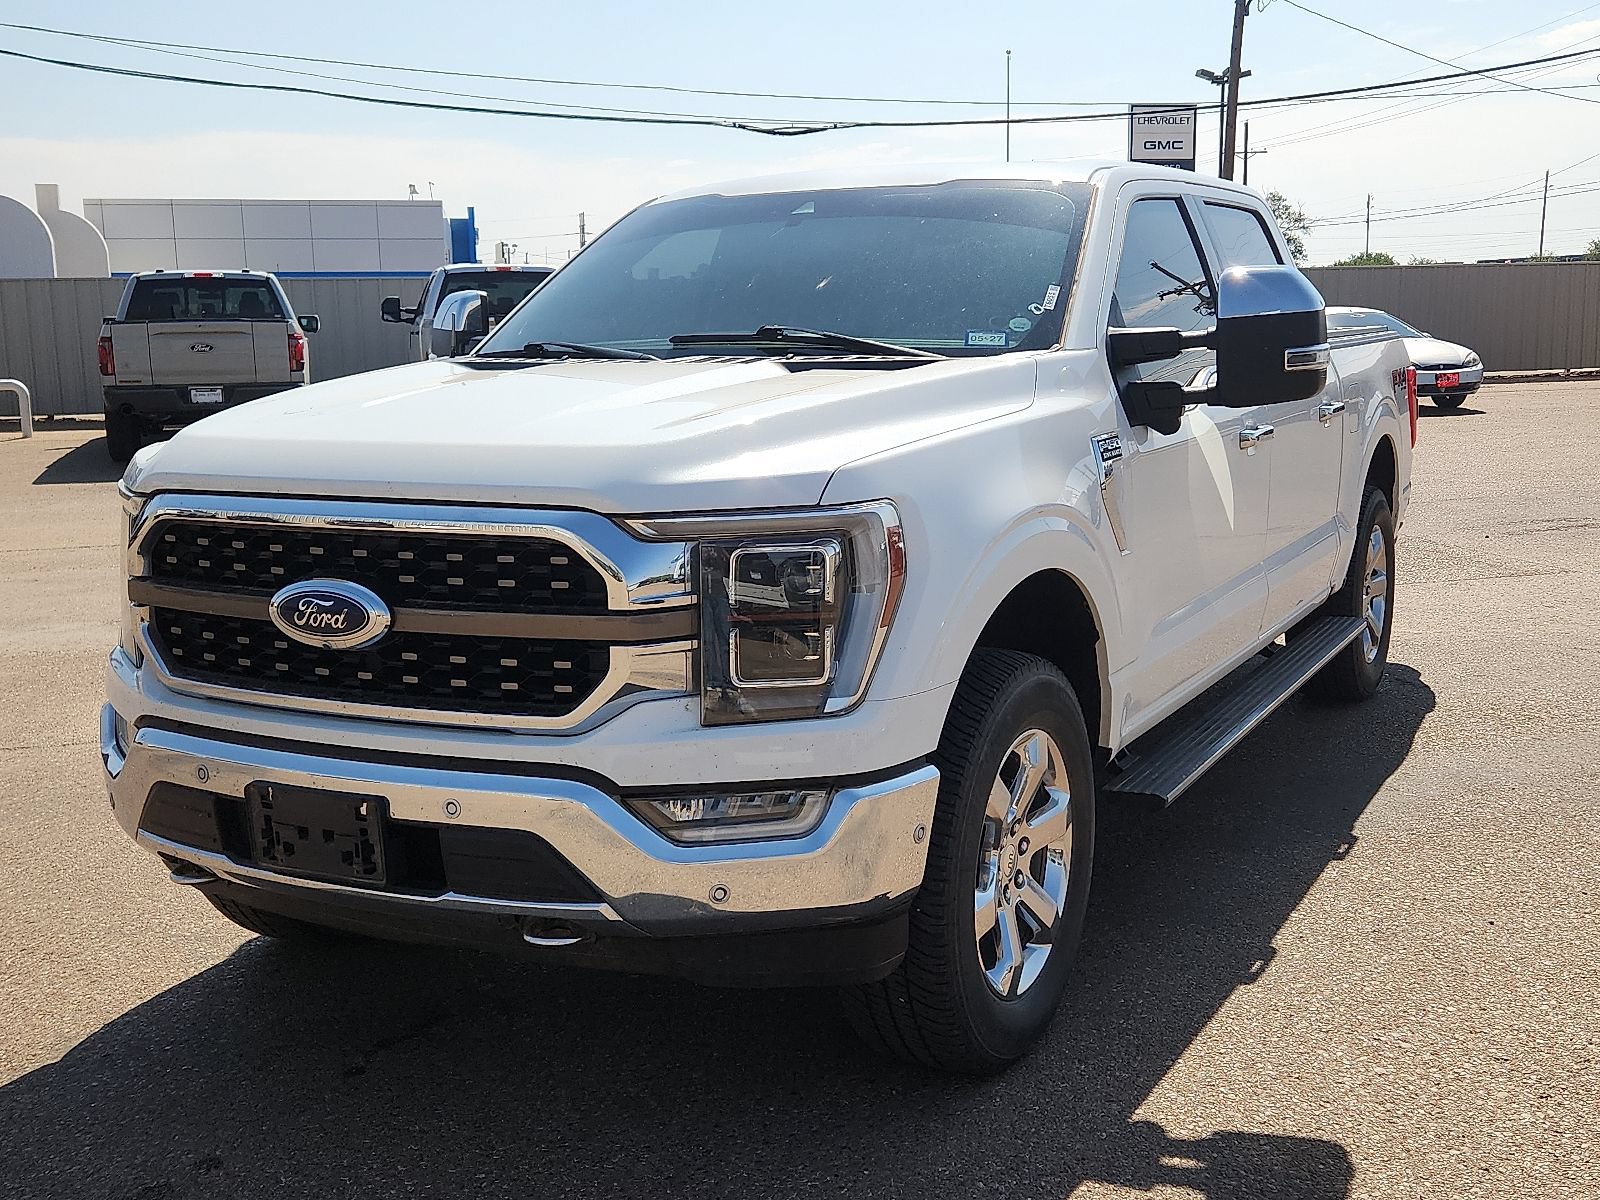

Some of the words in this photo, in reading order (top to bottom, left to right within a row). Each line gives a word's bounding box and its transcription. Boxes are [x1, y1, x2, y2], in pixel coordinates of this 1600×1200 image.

[1137, 117, 1191, 125] CHEVROLET
[1143, 140, 1184, 150] GMC
[294, 598, 348, 629] Ford
